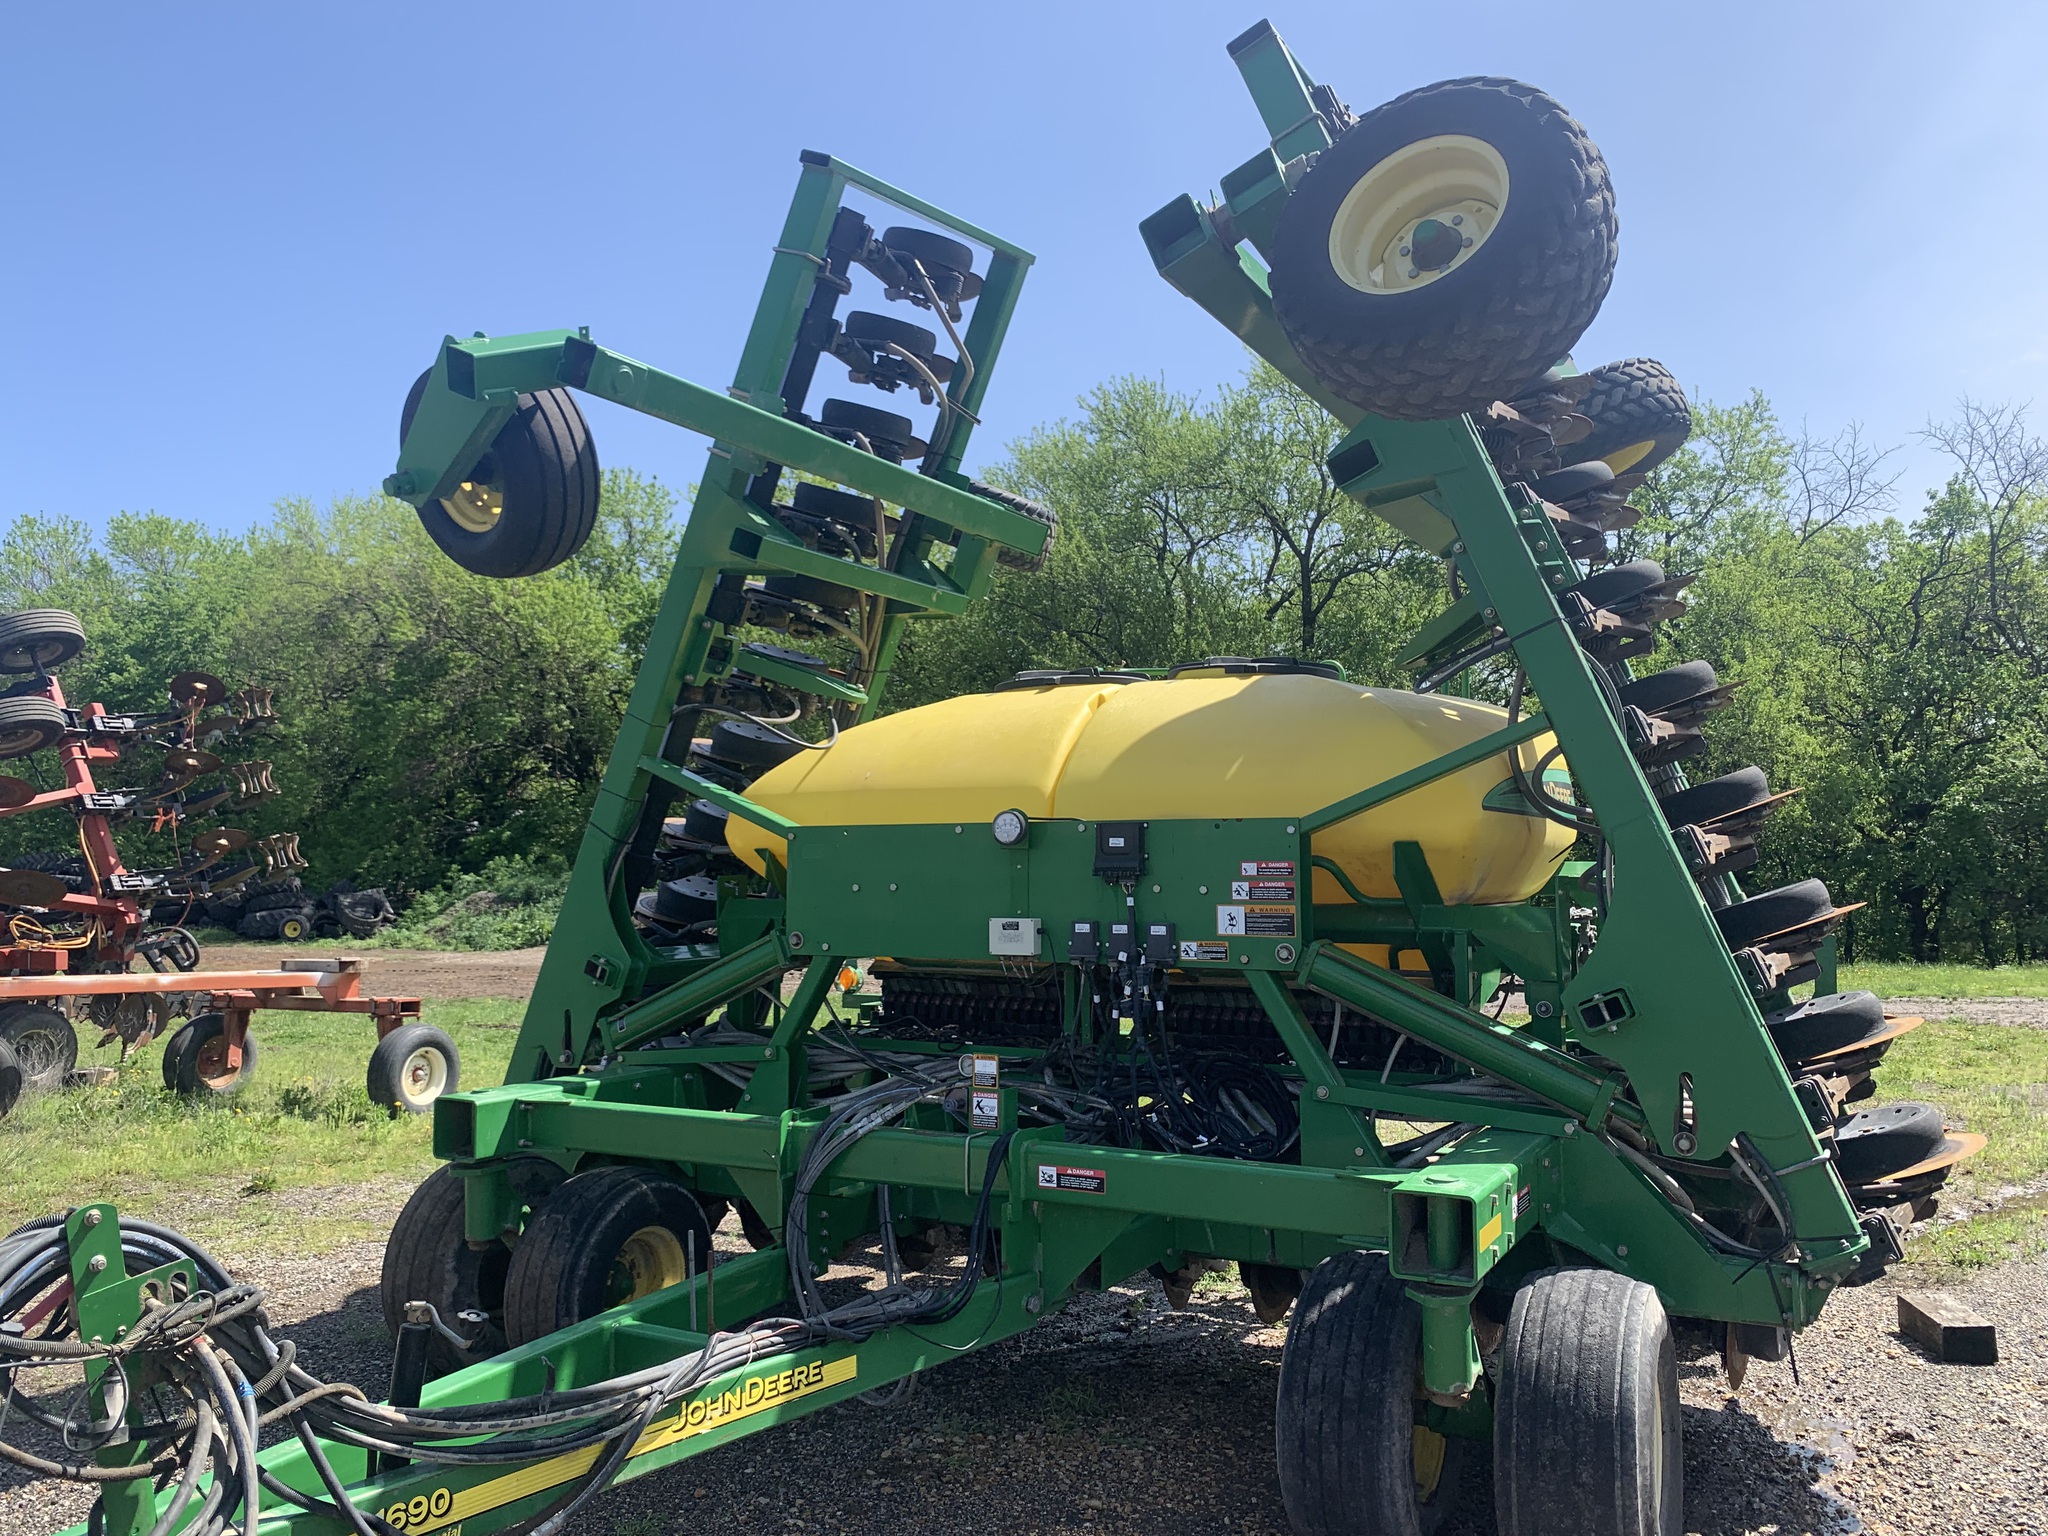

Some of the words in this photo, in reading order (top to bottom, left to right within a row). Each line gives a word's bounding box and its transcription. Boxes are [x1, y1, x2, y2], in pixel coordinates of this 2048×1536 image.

[1072, 1168, 1094, 1176] DANGER
[672, 1385, 743, 1433] JOHN
[745, 1360, 823, 1408] DEERE
